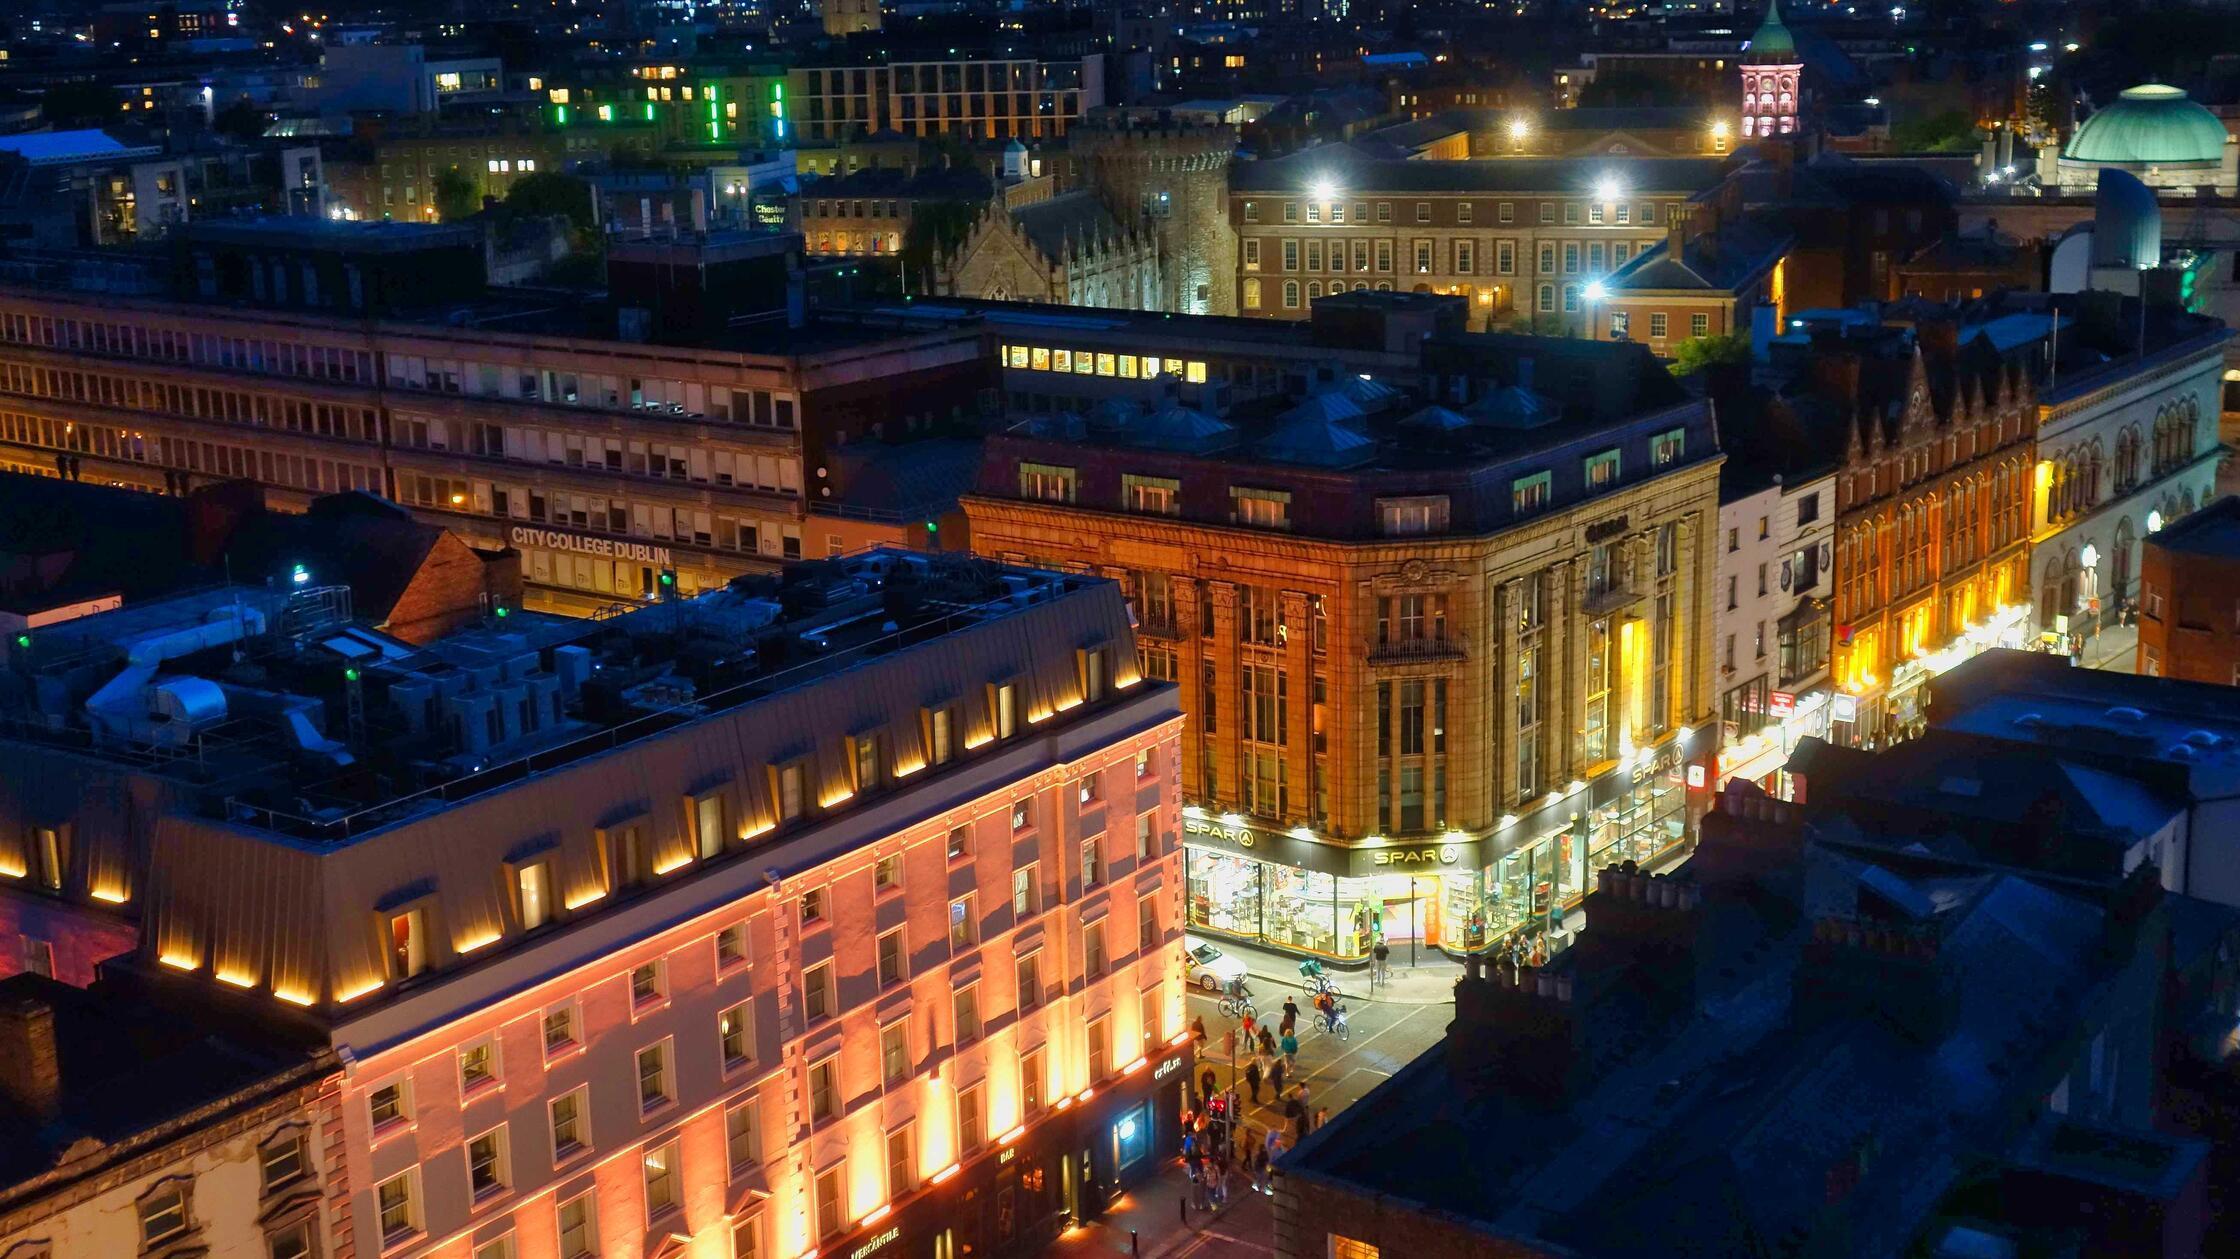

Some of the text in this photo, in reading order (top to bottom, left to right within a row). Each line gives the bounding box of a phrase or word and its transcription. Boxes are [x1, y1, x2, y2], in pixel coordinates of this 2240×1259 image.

[512, 526, 670, 565] CITY COLLEGE DUBLIN
[1632, 753, 1671, 784] SPAR
[1185, 822, 1236, 841] SPAR
[1374, 849, 1436, 865] SPAR
[1000, 1148, 1015, 1164] BAR
